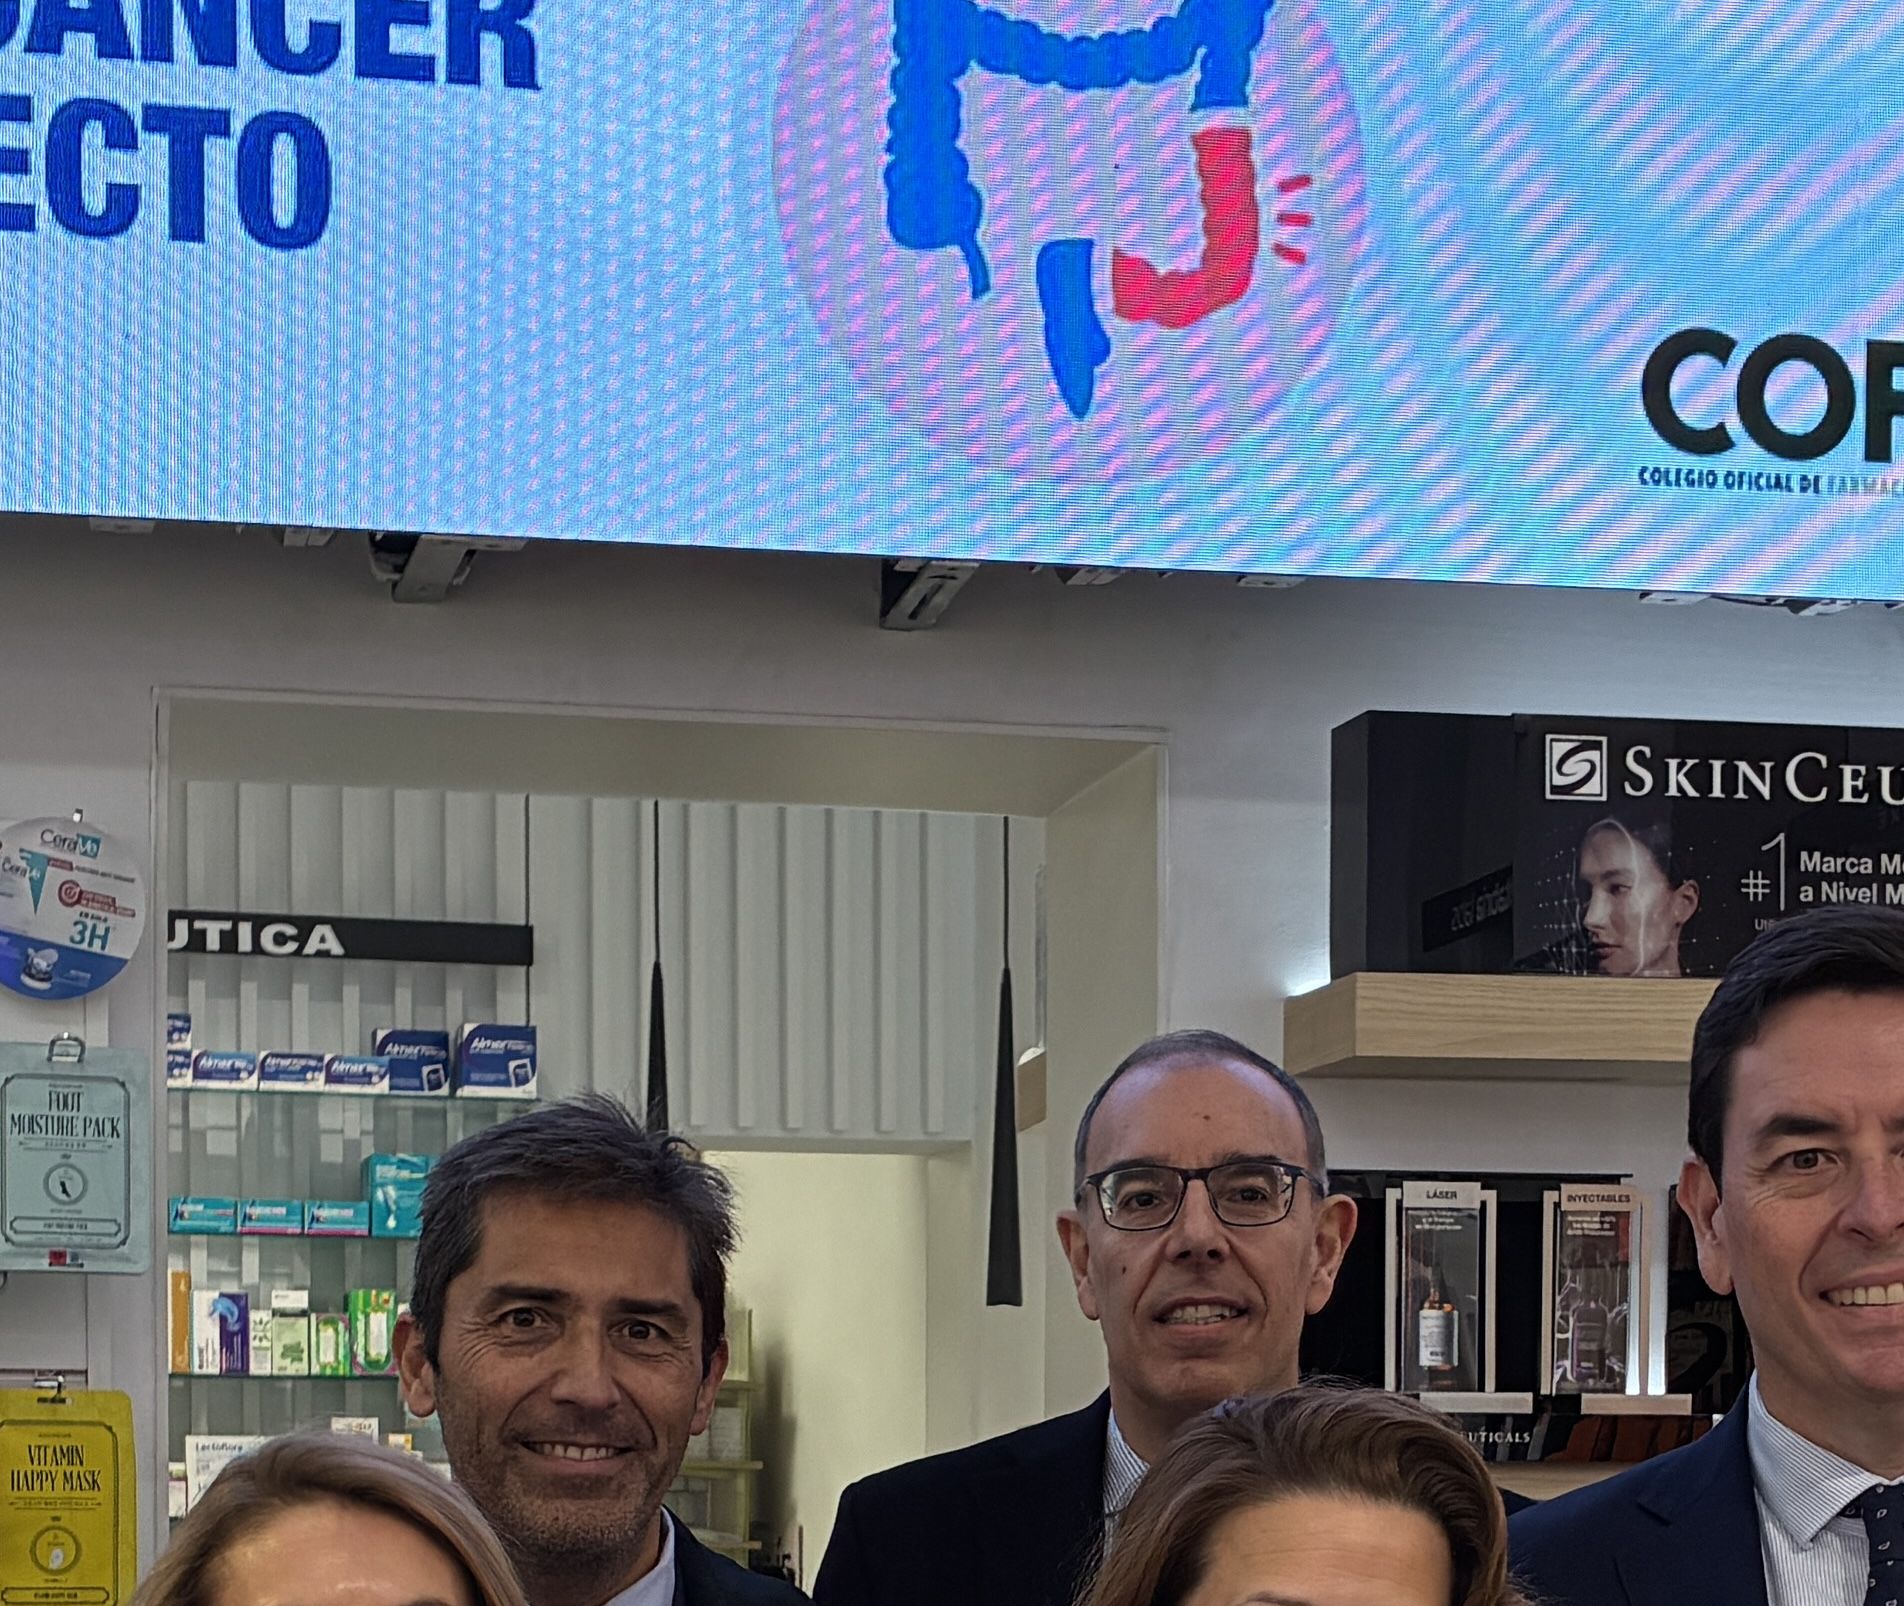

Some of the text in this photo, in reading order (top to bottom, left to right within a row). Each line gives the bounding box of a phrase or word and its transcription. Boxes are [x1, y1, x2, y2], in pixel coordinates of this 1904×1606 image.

[1638, 466, 1718, 489] COLEGIO
[1723, 470, 1795, 493] OFICIAL
[1799, 473, 1821, 494] DE
[1800, 851, 1873, 876] Marca
[1799, 886, 1814, 902] a
[1823, 882, 1879, 904] Nivel
[69, 920, 111, 952] 3H
[47, 1089, 84, 1112] FOOT
[10, 1113, 122, 1139] MOISTURE PACK
[1425, 1189, 1458, 1200] LÁSER
[27, 1444, 85, 1467] VITAMIN
[10, 1469, 102, 1493] HAPPY MASK
